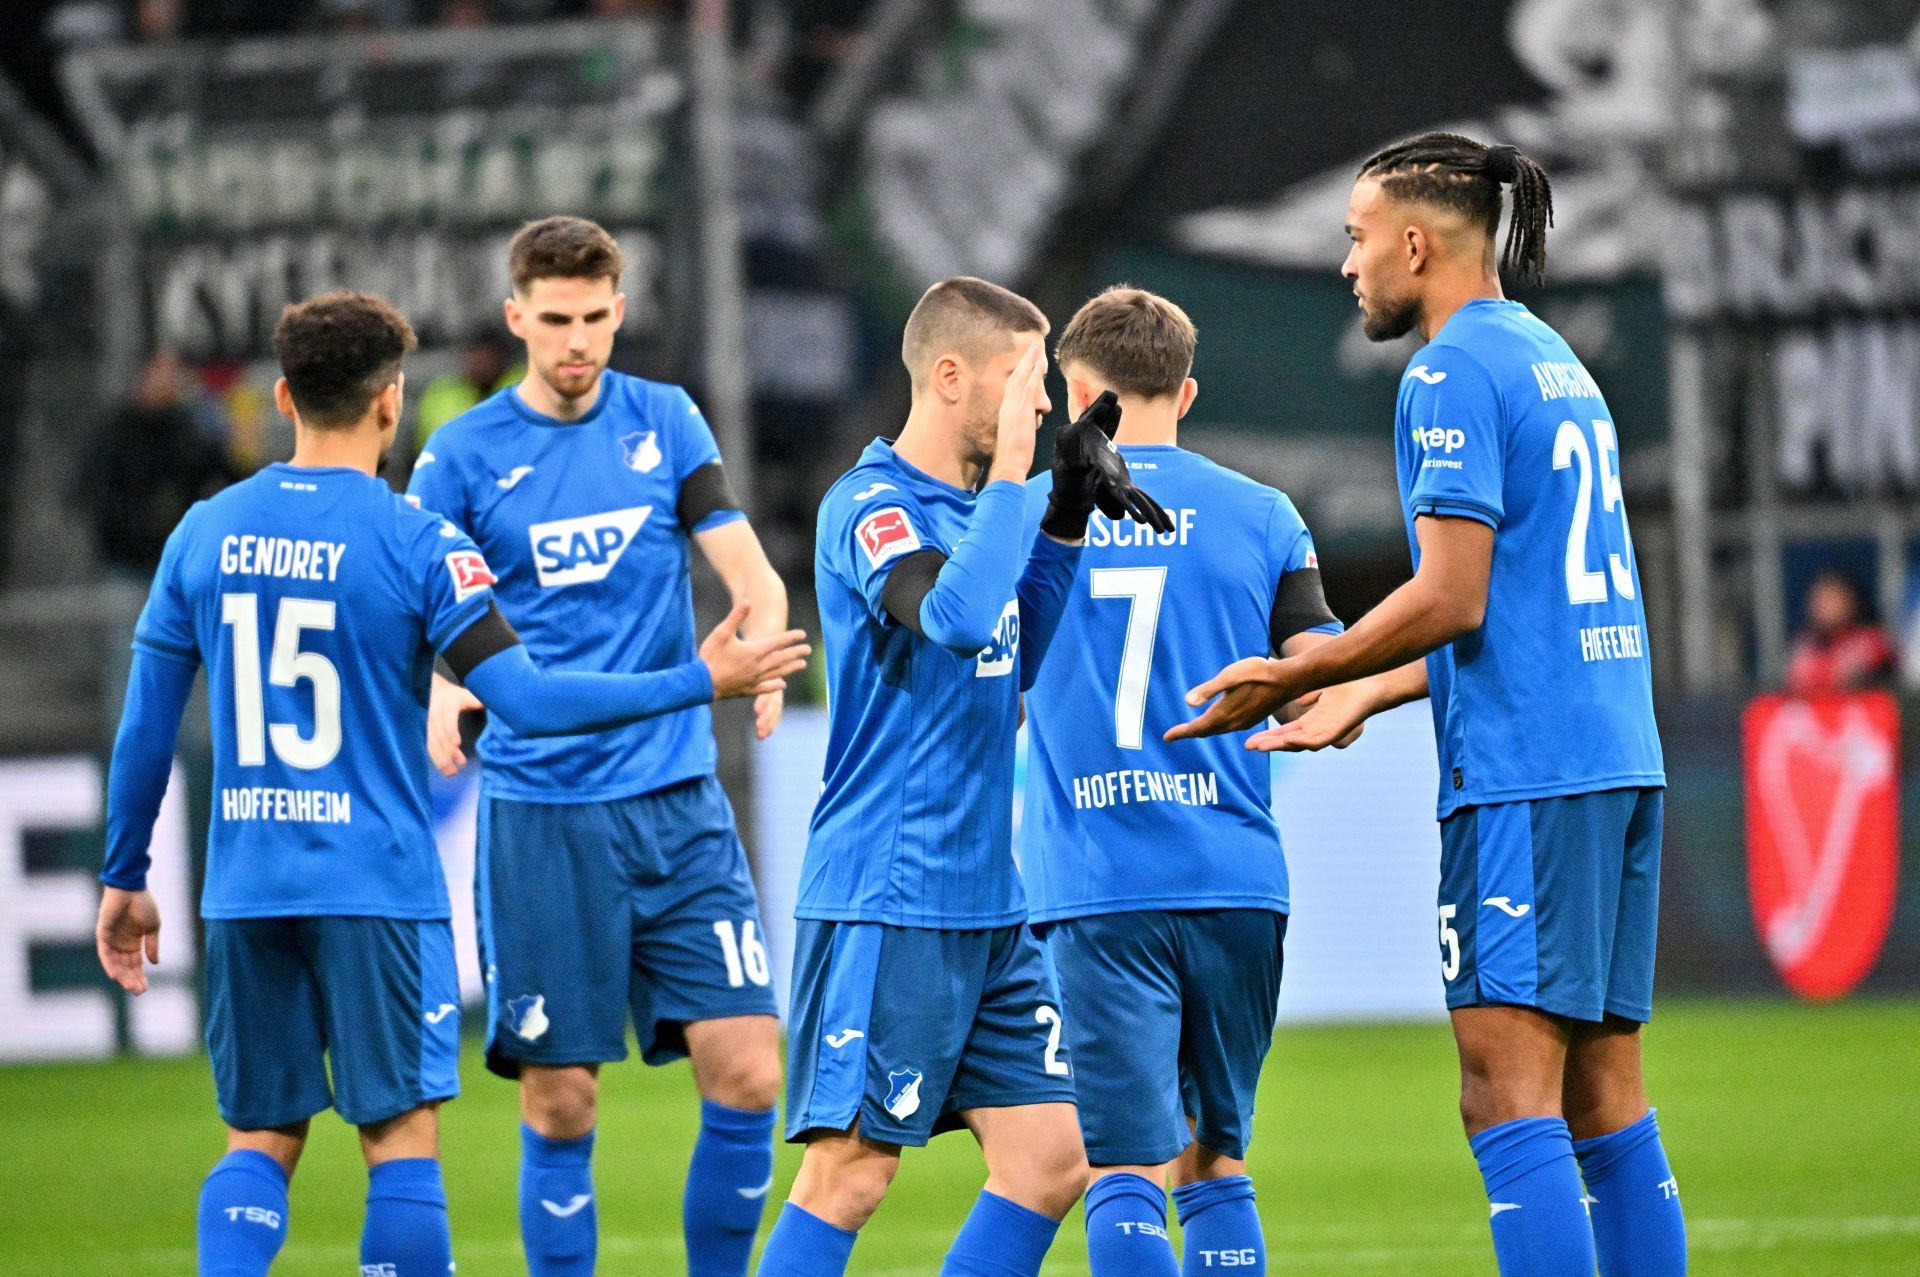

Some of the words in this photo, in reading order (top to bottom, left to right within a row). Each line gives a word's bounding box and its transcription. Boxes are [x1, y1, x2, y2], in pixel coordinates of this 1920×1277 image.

[1418, 426, 1465, 453] hep
[1553, 419, 1635, 604] 25
[221, 535, 346, 581] GENDREY
[536, 525, 624, 574] SAP
[1090, 566, 1168, 750] 7
[222, 593, 342, 770] 15
[222, 788, 350, 823] HOFFENHEIM
[1074, 769, 1219, 809] HOFFENHEIM
[713, 920, 770, 988] 16
[1035, 1005, 1074, 1078] 2
[224, 1206, 281, 1229] TSG
[361, 1263, 397, 1277] SG
[1200, 1248, 1256, 1267] TSG
